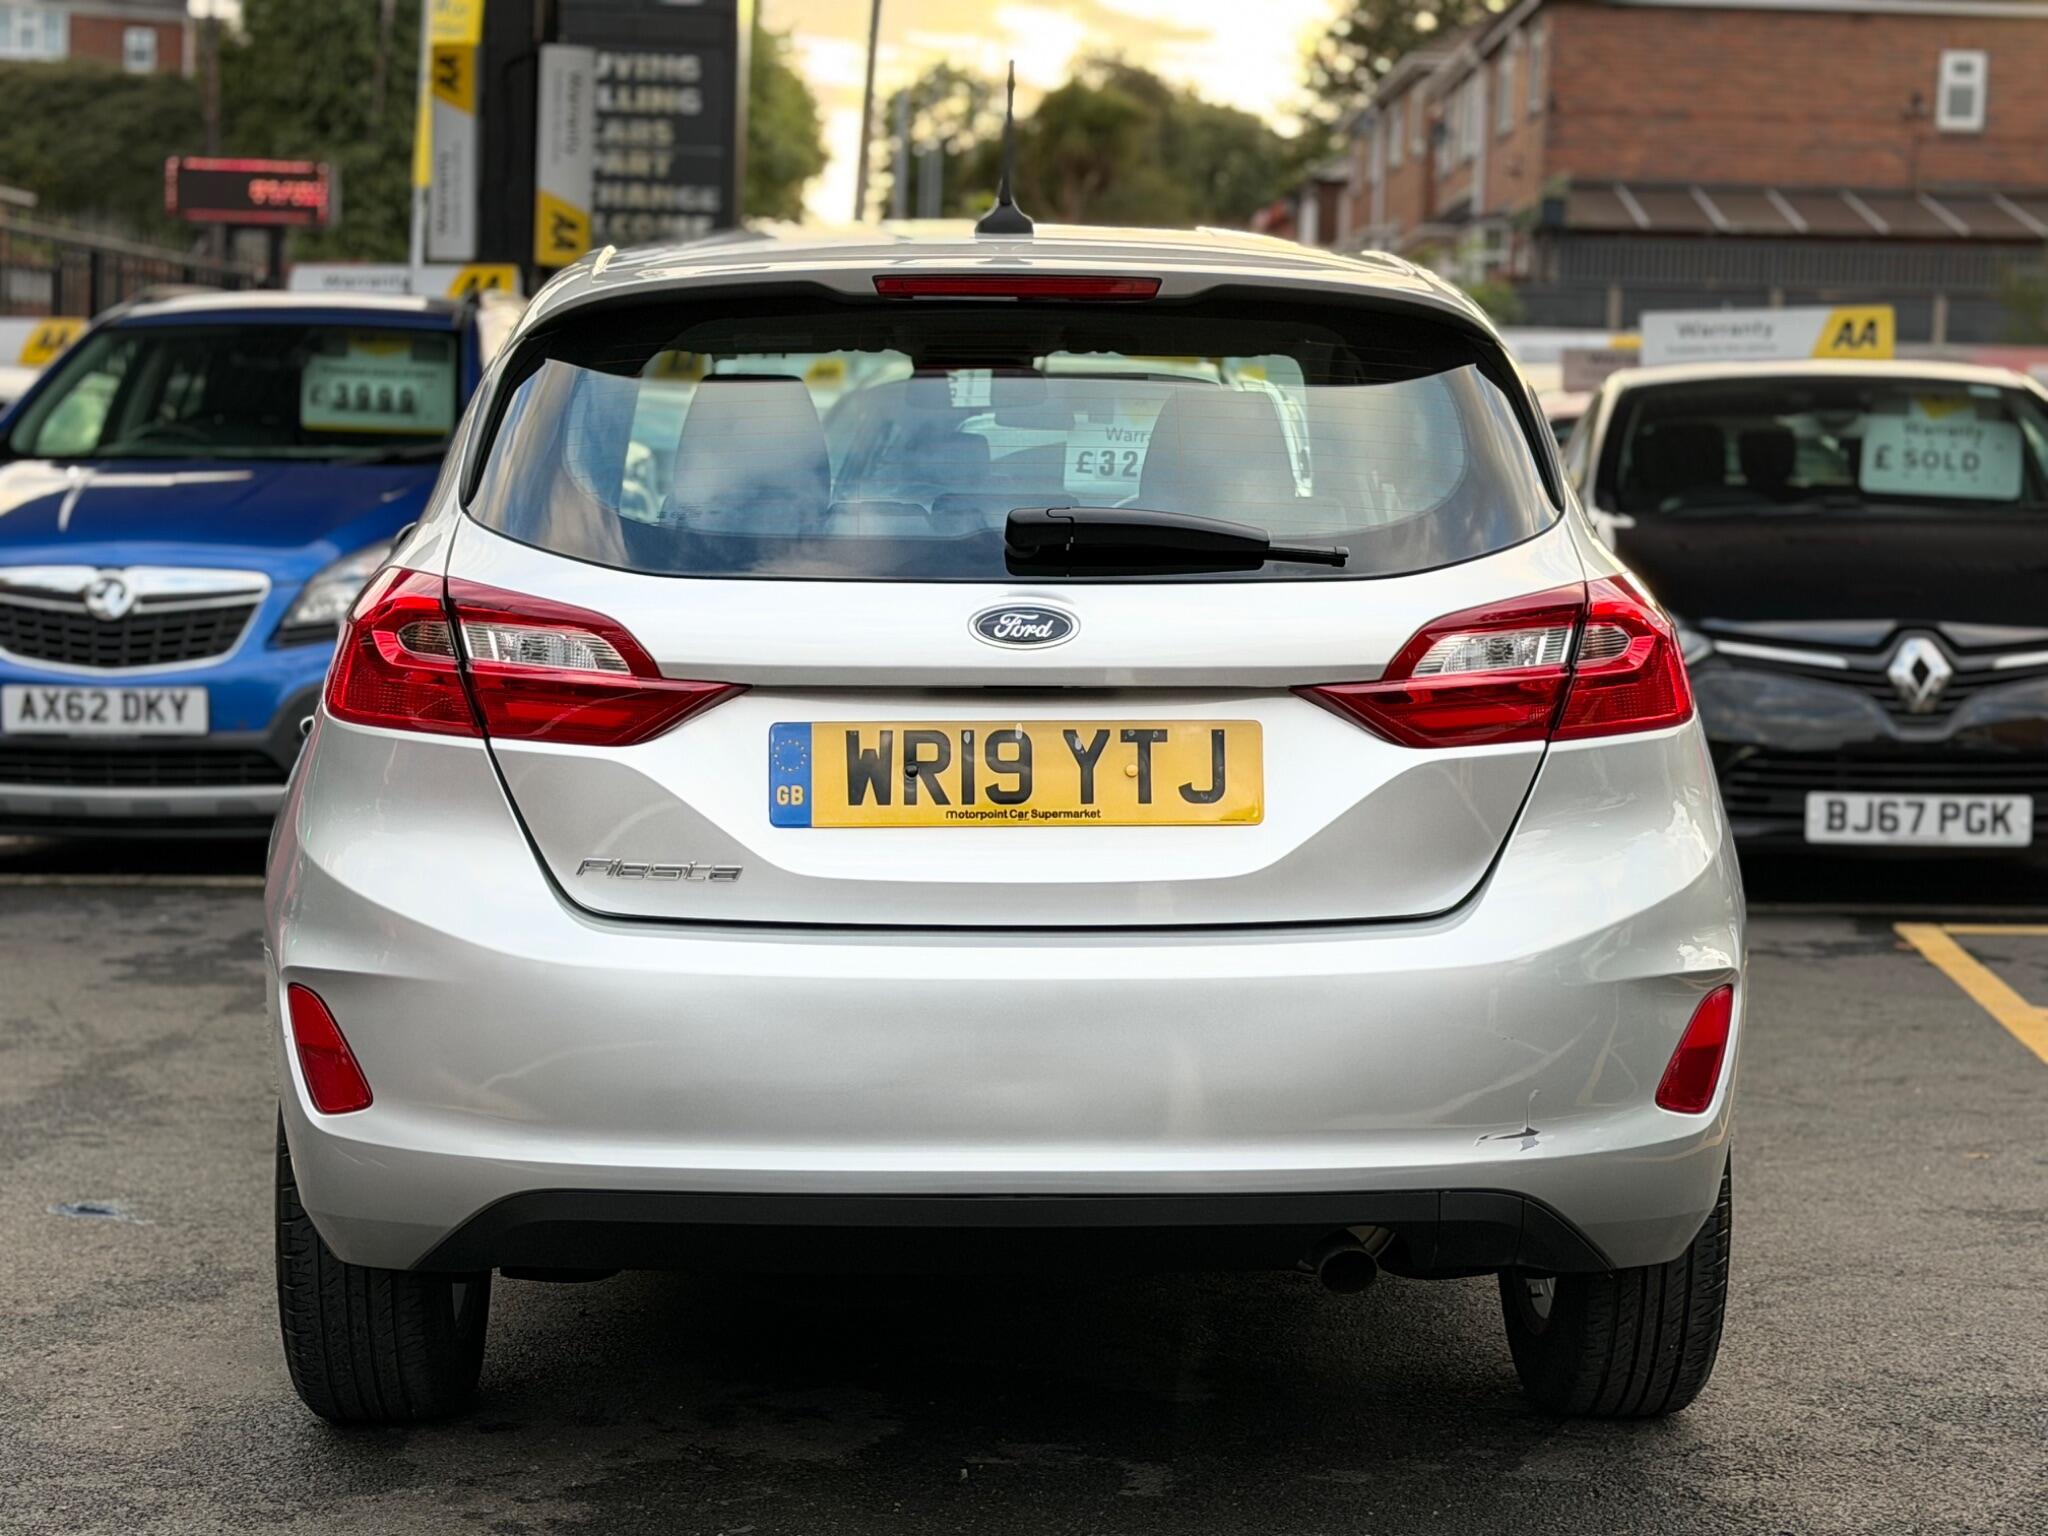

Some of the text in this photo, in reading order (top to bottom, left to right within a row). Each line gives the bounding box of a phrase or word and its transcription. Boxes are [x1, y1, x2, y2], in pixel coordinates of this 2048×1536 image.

[1675, 319, 1880, 350] Warranty AA
[1105, 426, 1149, 442] Warr
[1904, 447, 1981, 473] SOLD
[993, 613, 1054, 638] Ford
[20, 689, 189, 723] AX62 DKY
[845, 728, 1226, 806] WR19 YTJ
[776, 784, 804, 806] GB
[1009, 808, 1029, 819] Car
[1030, 808, 1101, 820] Supermarket
[1826, 799, 2013, 835] BJ67 PGK
[576, 857, 743, 882] Fiesta
